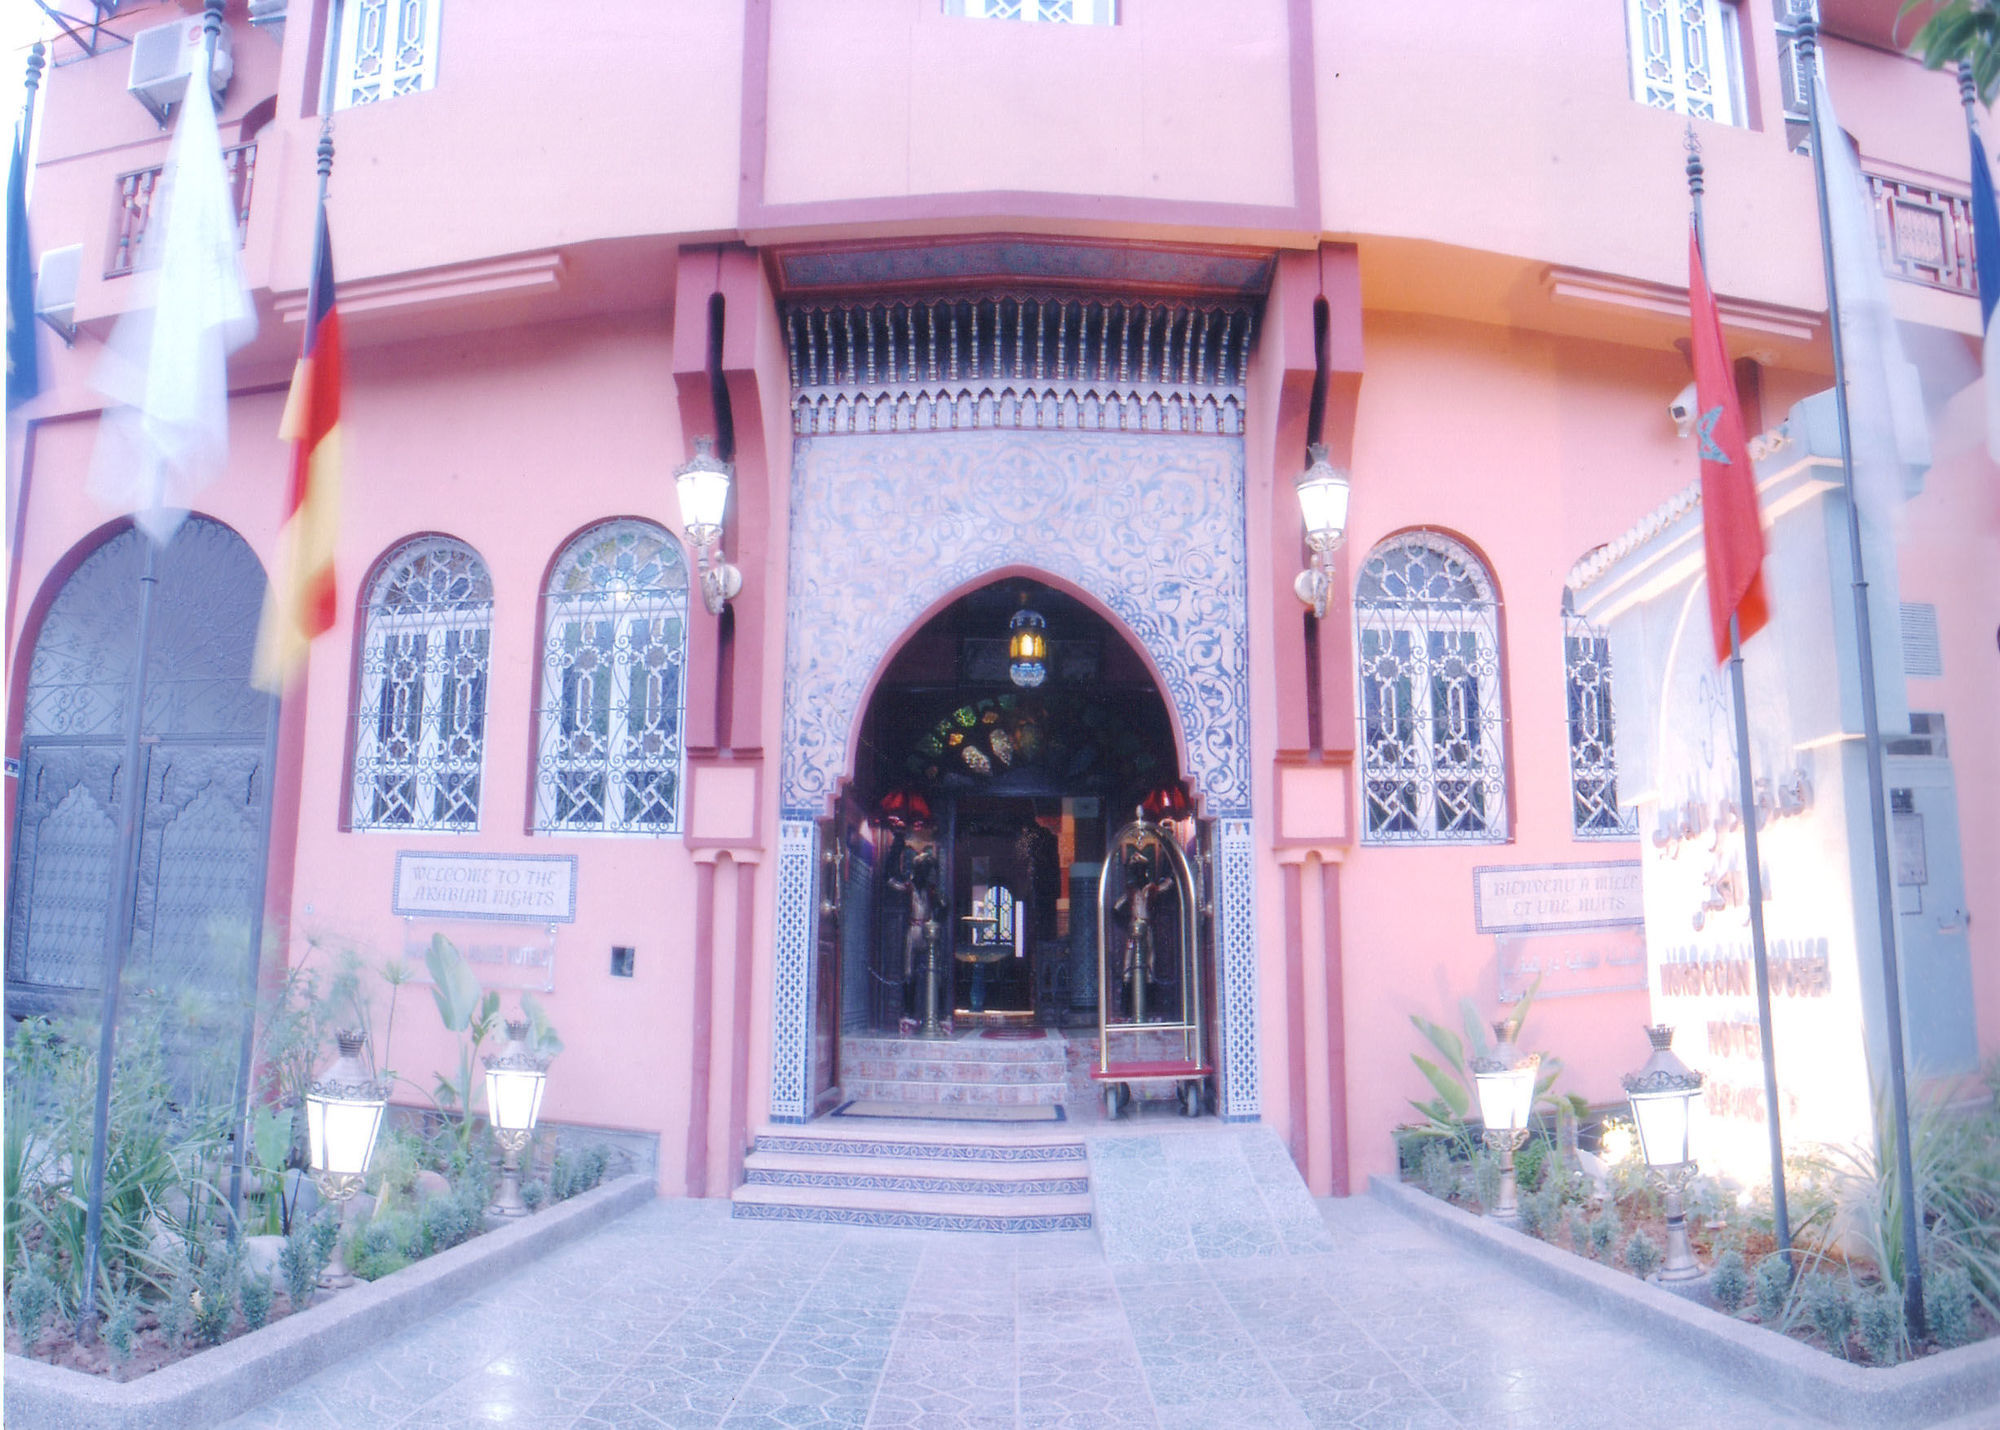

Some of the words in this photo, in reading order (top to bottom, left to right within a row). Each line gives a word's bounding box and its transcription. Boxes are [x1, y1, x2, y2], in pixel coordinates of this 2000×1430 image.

[413, 866, 492, 884] WELCOME
[497, 868, 520, 885] TO
[527, 870, 557, 887] THE
[1494, 878, 1574, 897] BIENVENU
[1595, 873, 1638, 890] MILLE
[414, 885, 488, 904] ARABIAN
[493, 889, 555, 908] NIGHTS
[1513, 902, 1531, 916] ET
[1537, 899, 1569, 915] UNE
[1579, 896, 1626, 912] NUITS
